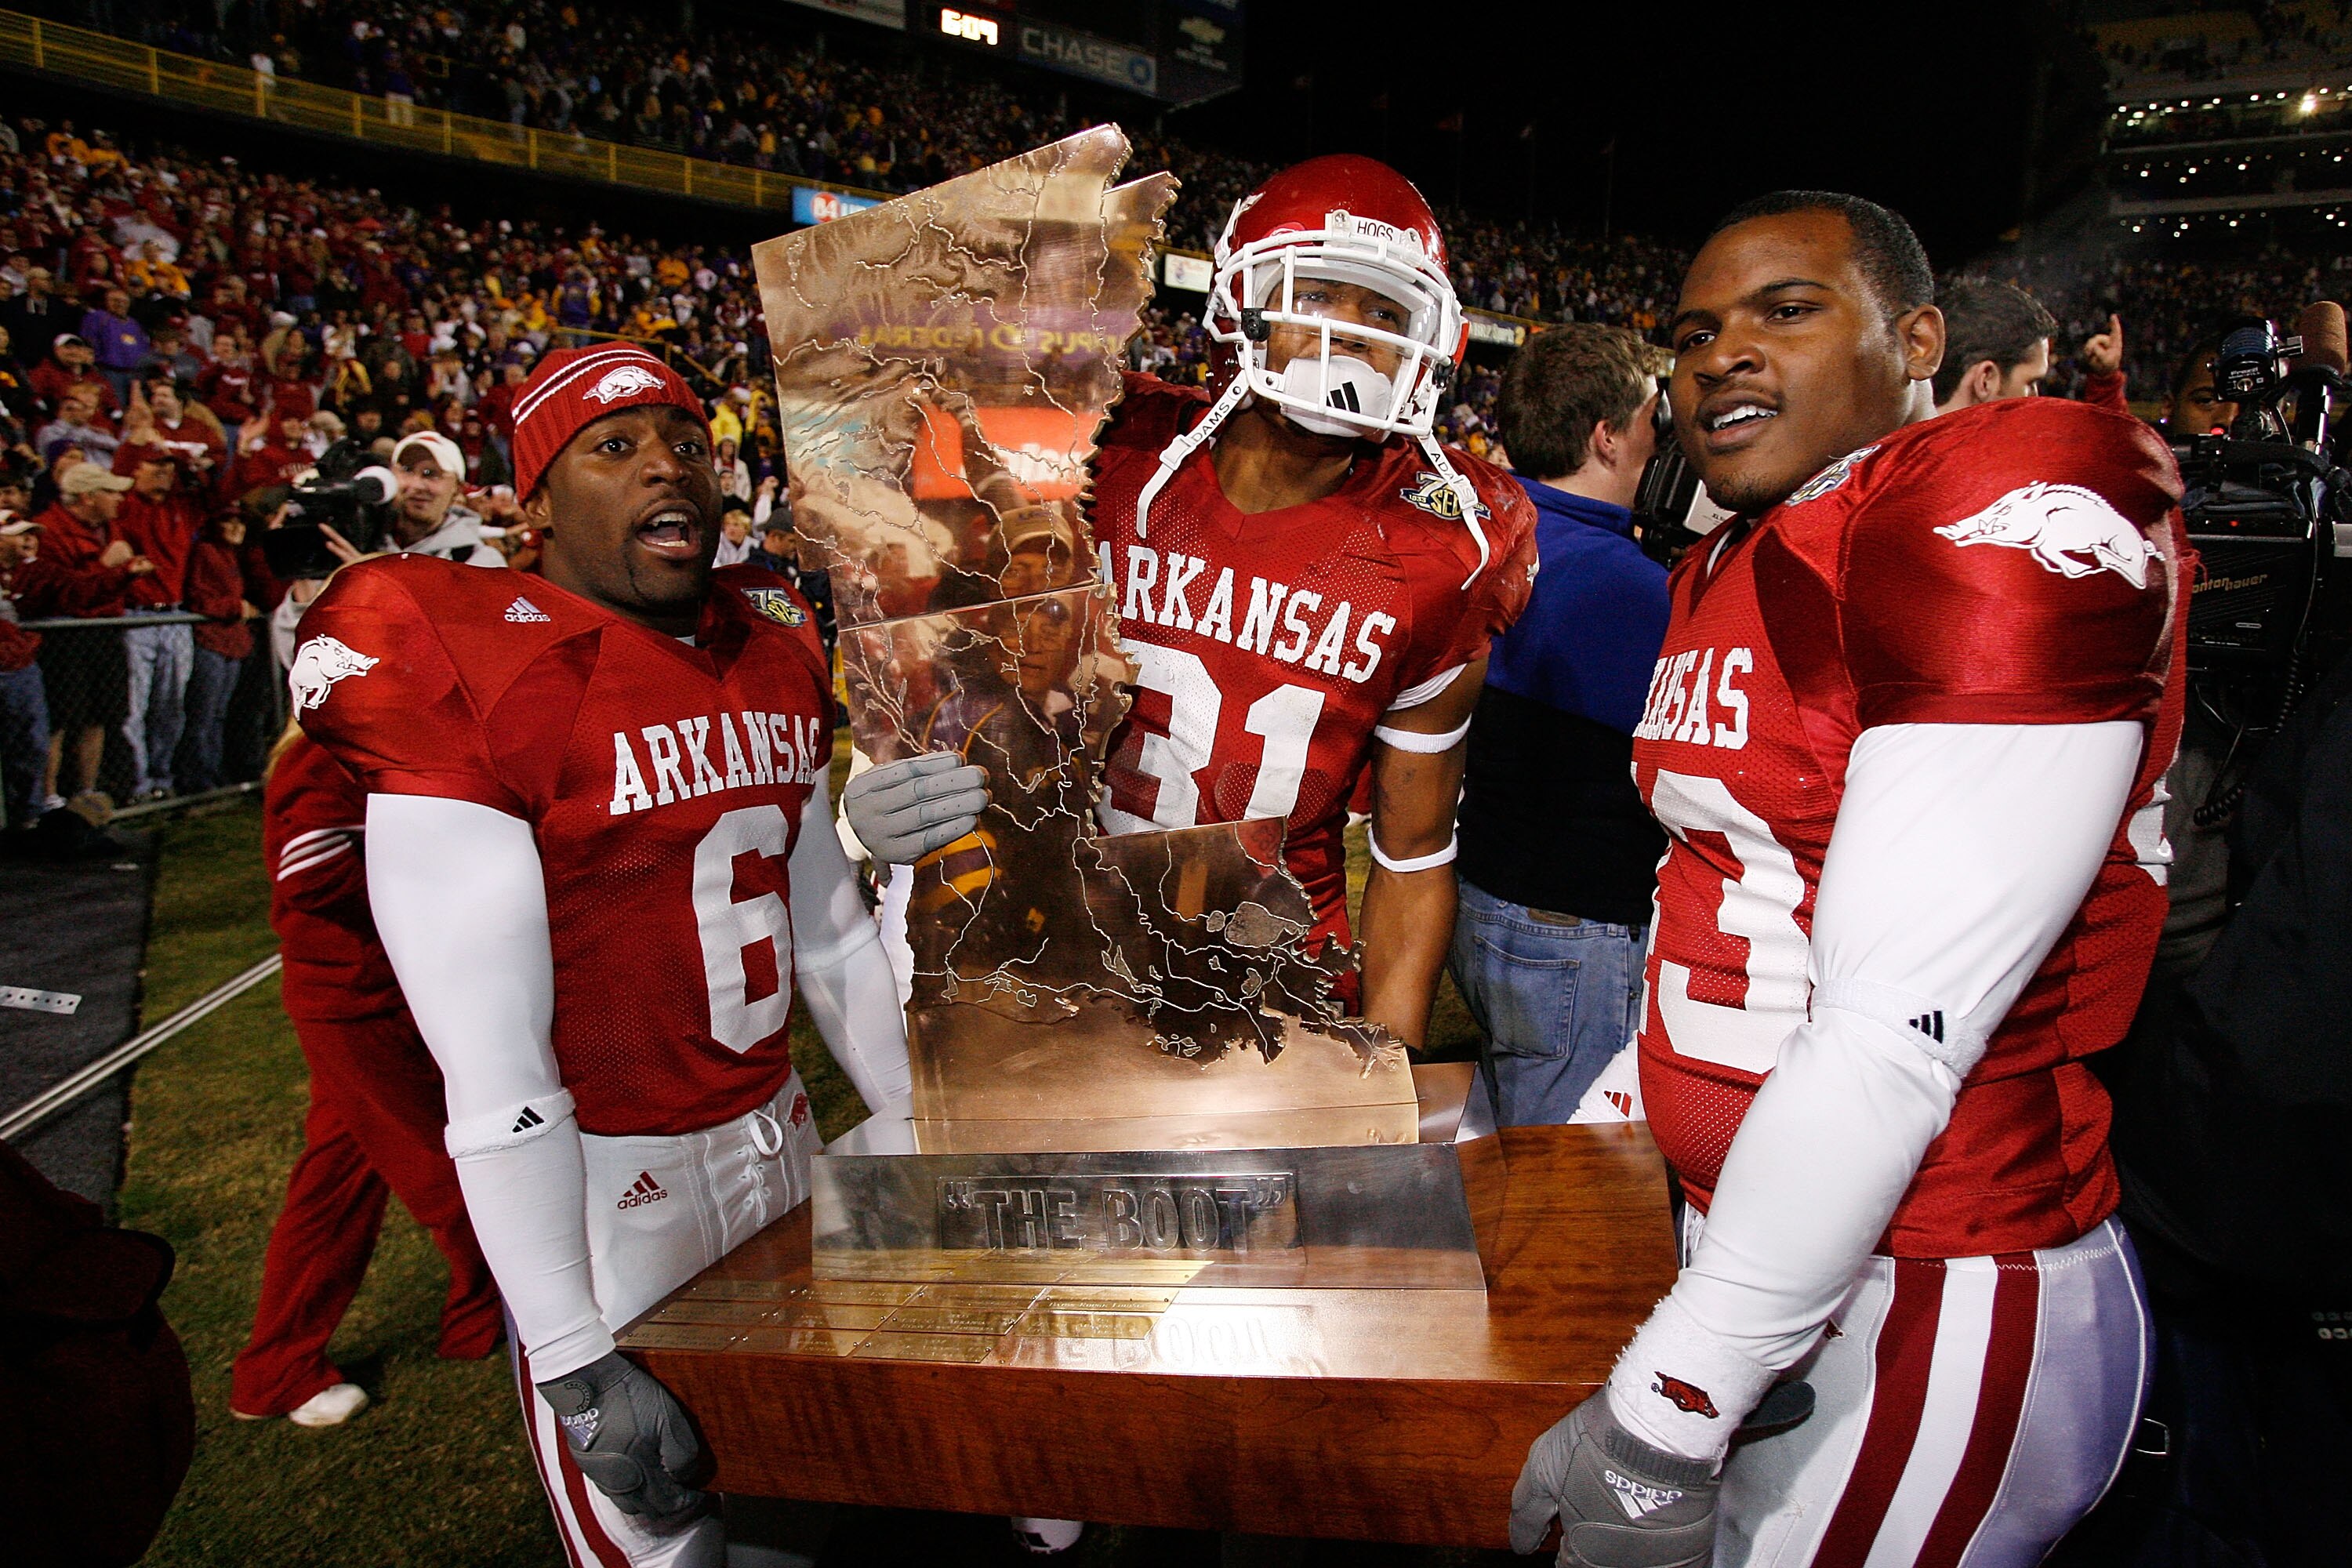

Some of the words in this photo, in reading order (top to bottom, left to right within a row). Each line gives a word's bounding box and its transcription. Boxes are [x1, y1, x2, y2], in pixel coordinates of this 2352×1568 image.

[1022, 27, 1124, 71] CHASE
[1356, 220, 1393, 241] HOGS
[1191, 401, 1230, 443] DAMS
[504, 612, 551, 623] adidas
[1098, 637, 1327, 837] 31
[609, 710, 821, 816] ARKANSAS
[692, 804, 793, 1054] 6
[617, 1189, 669, 1210] adidas
[559, 1407, 599, 1428] adida
[1605, 1469, 1682, 1501] adidas
